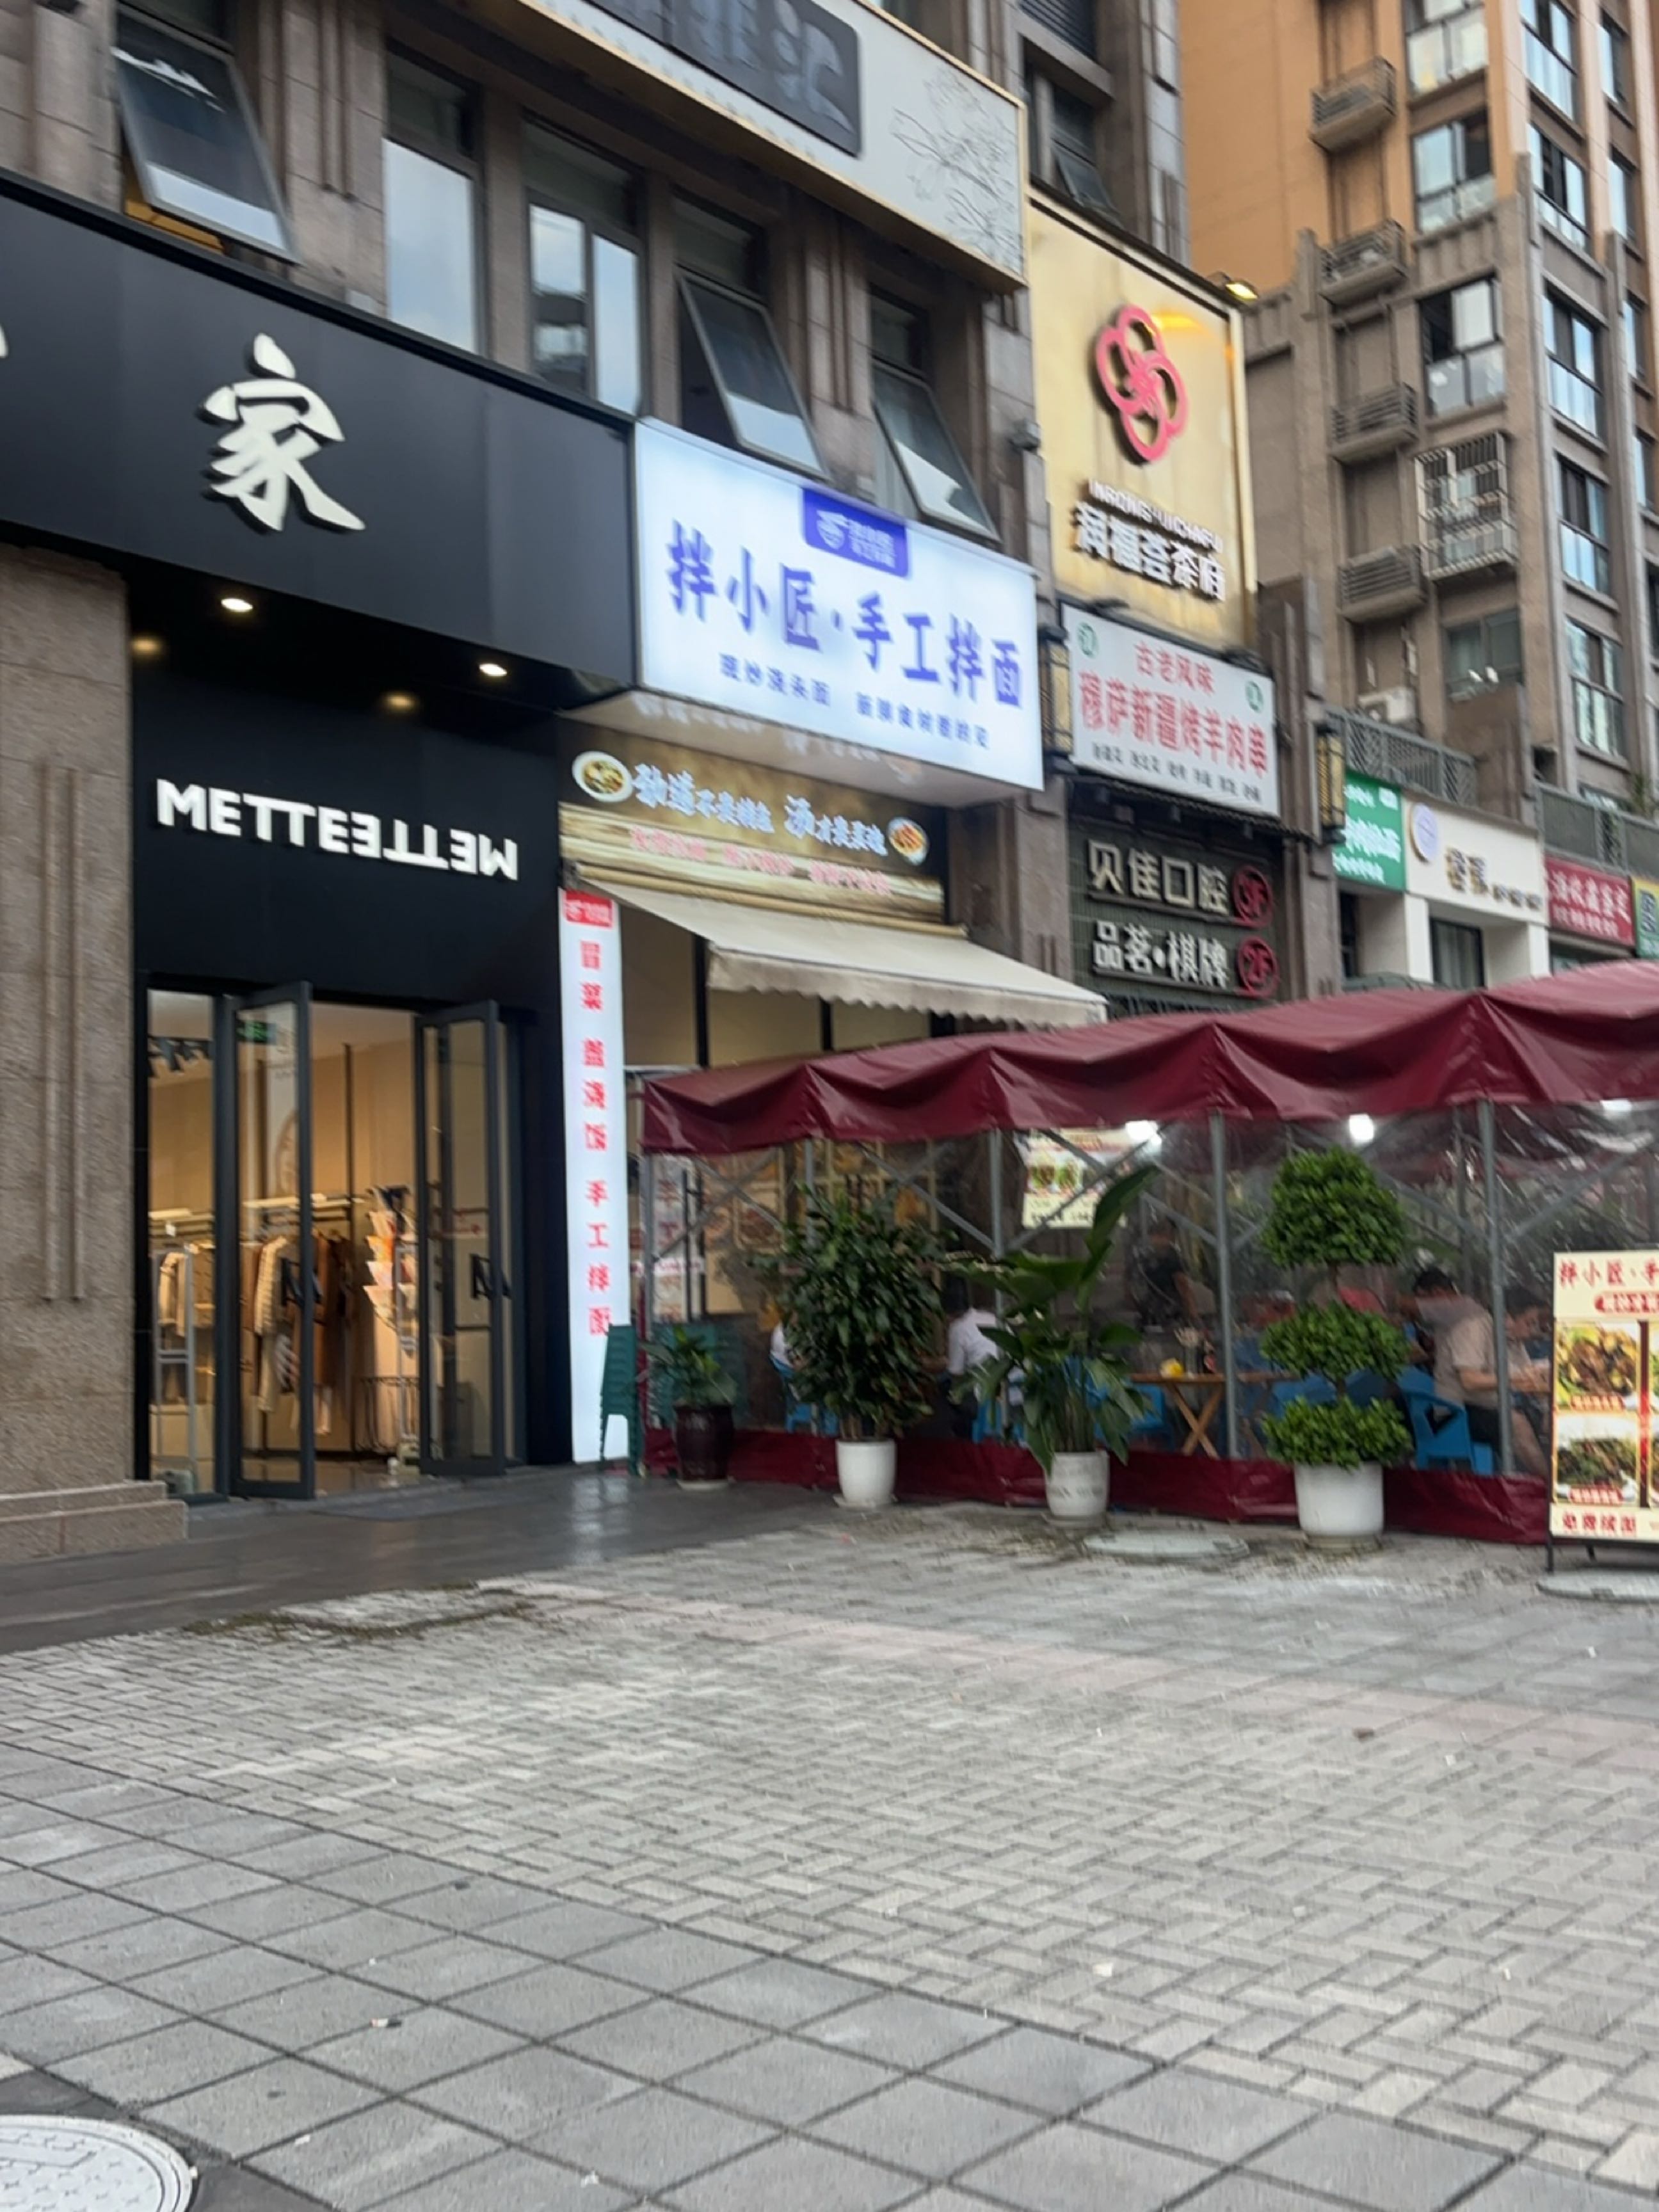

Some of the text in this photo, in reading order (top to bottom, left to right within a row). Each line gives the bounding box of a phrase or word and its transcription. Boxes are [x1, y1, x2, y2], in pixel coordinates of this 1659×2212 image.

[200, 332, 366, 532] 家
[1089, 839, 1228, 915] 贝佳口腔
